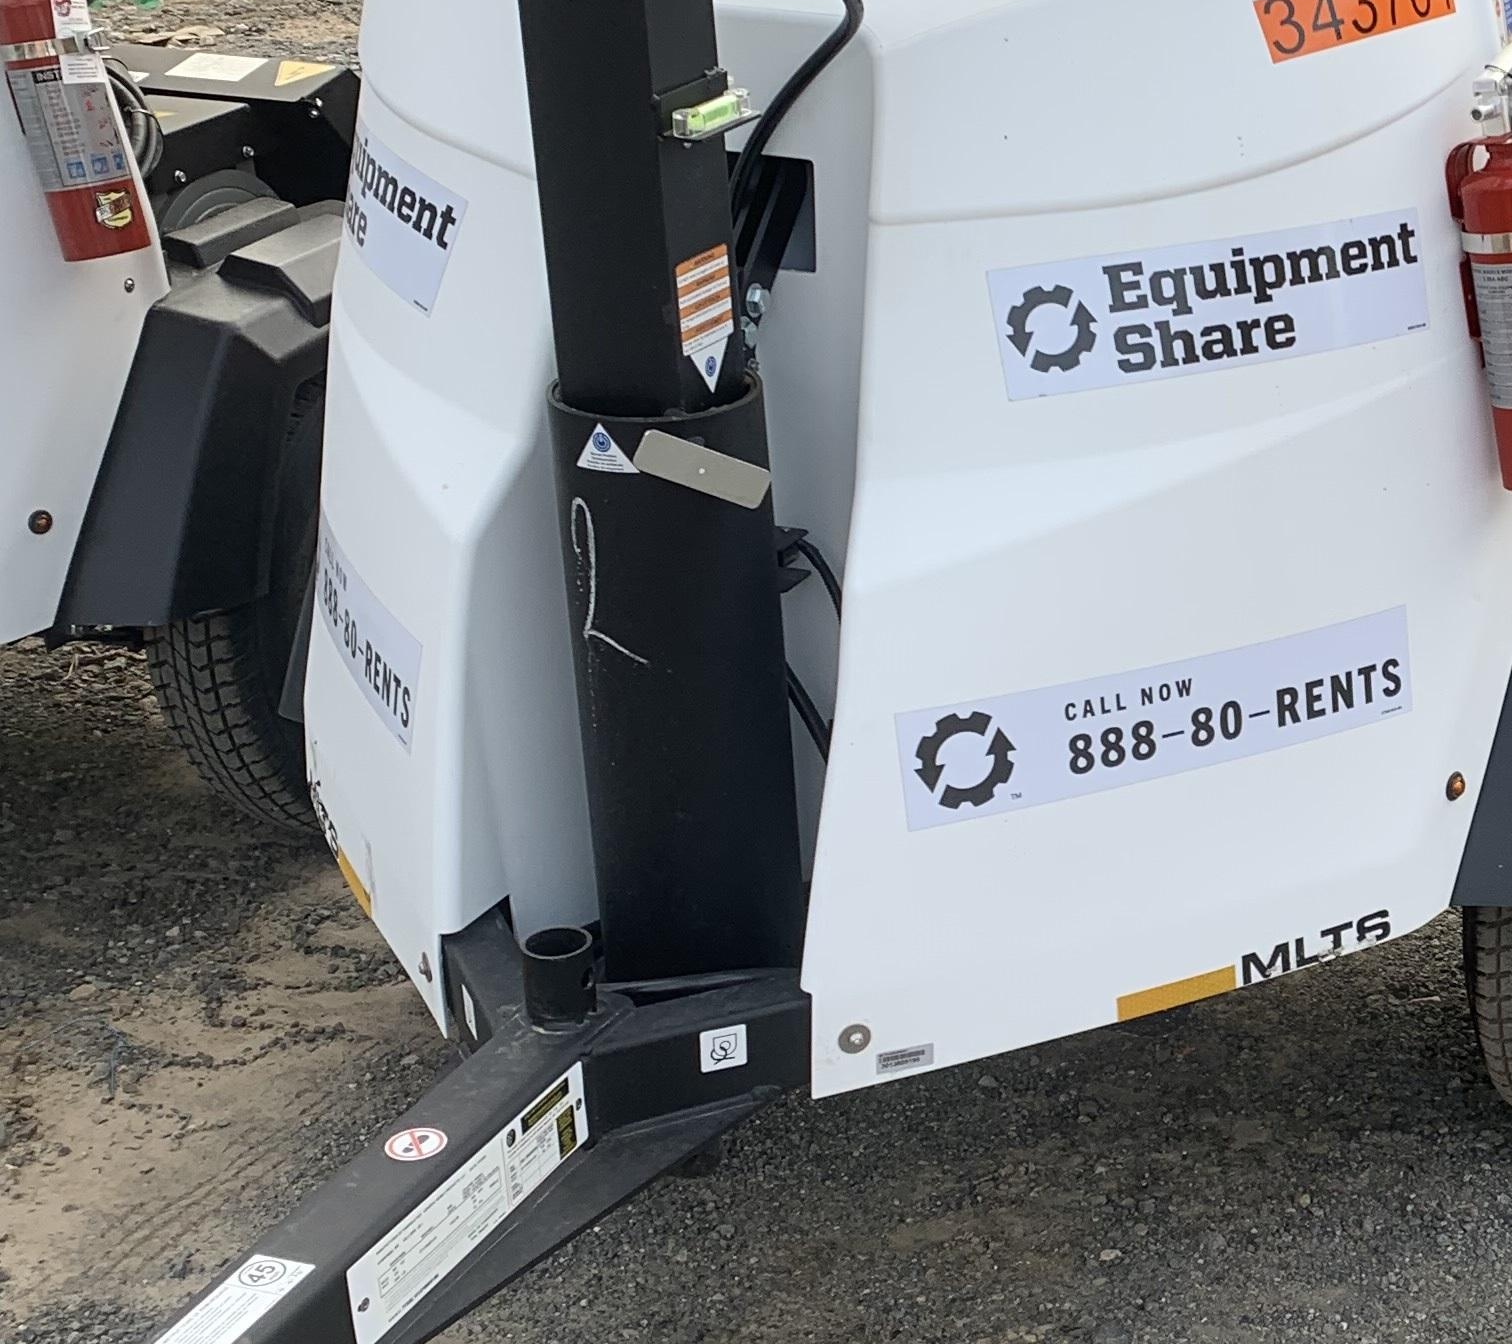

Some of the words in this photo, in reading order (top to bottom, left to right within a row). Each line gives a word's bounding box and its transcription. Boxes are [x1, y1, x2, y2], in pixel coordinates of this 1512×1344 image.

[36, 71, 61, 84] INST
[1102, 222, 1418, 316] Equipment
[1113, 313, 1296, 374] Share
[335, 558, 347, 592] NOW
[323, 568, 411, 729] 888-80-RENTS
[1064, 691, 1127, 722] CALL
[1140, 677, 1194, 706] NOW
[1068, 657, 1402, 776] 888-80-RENTS
[246, 1258, 277, 1286] 45
